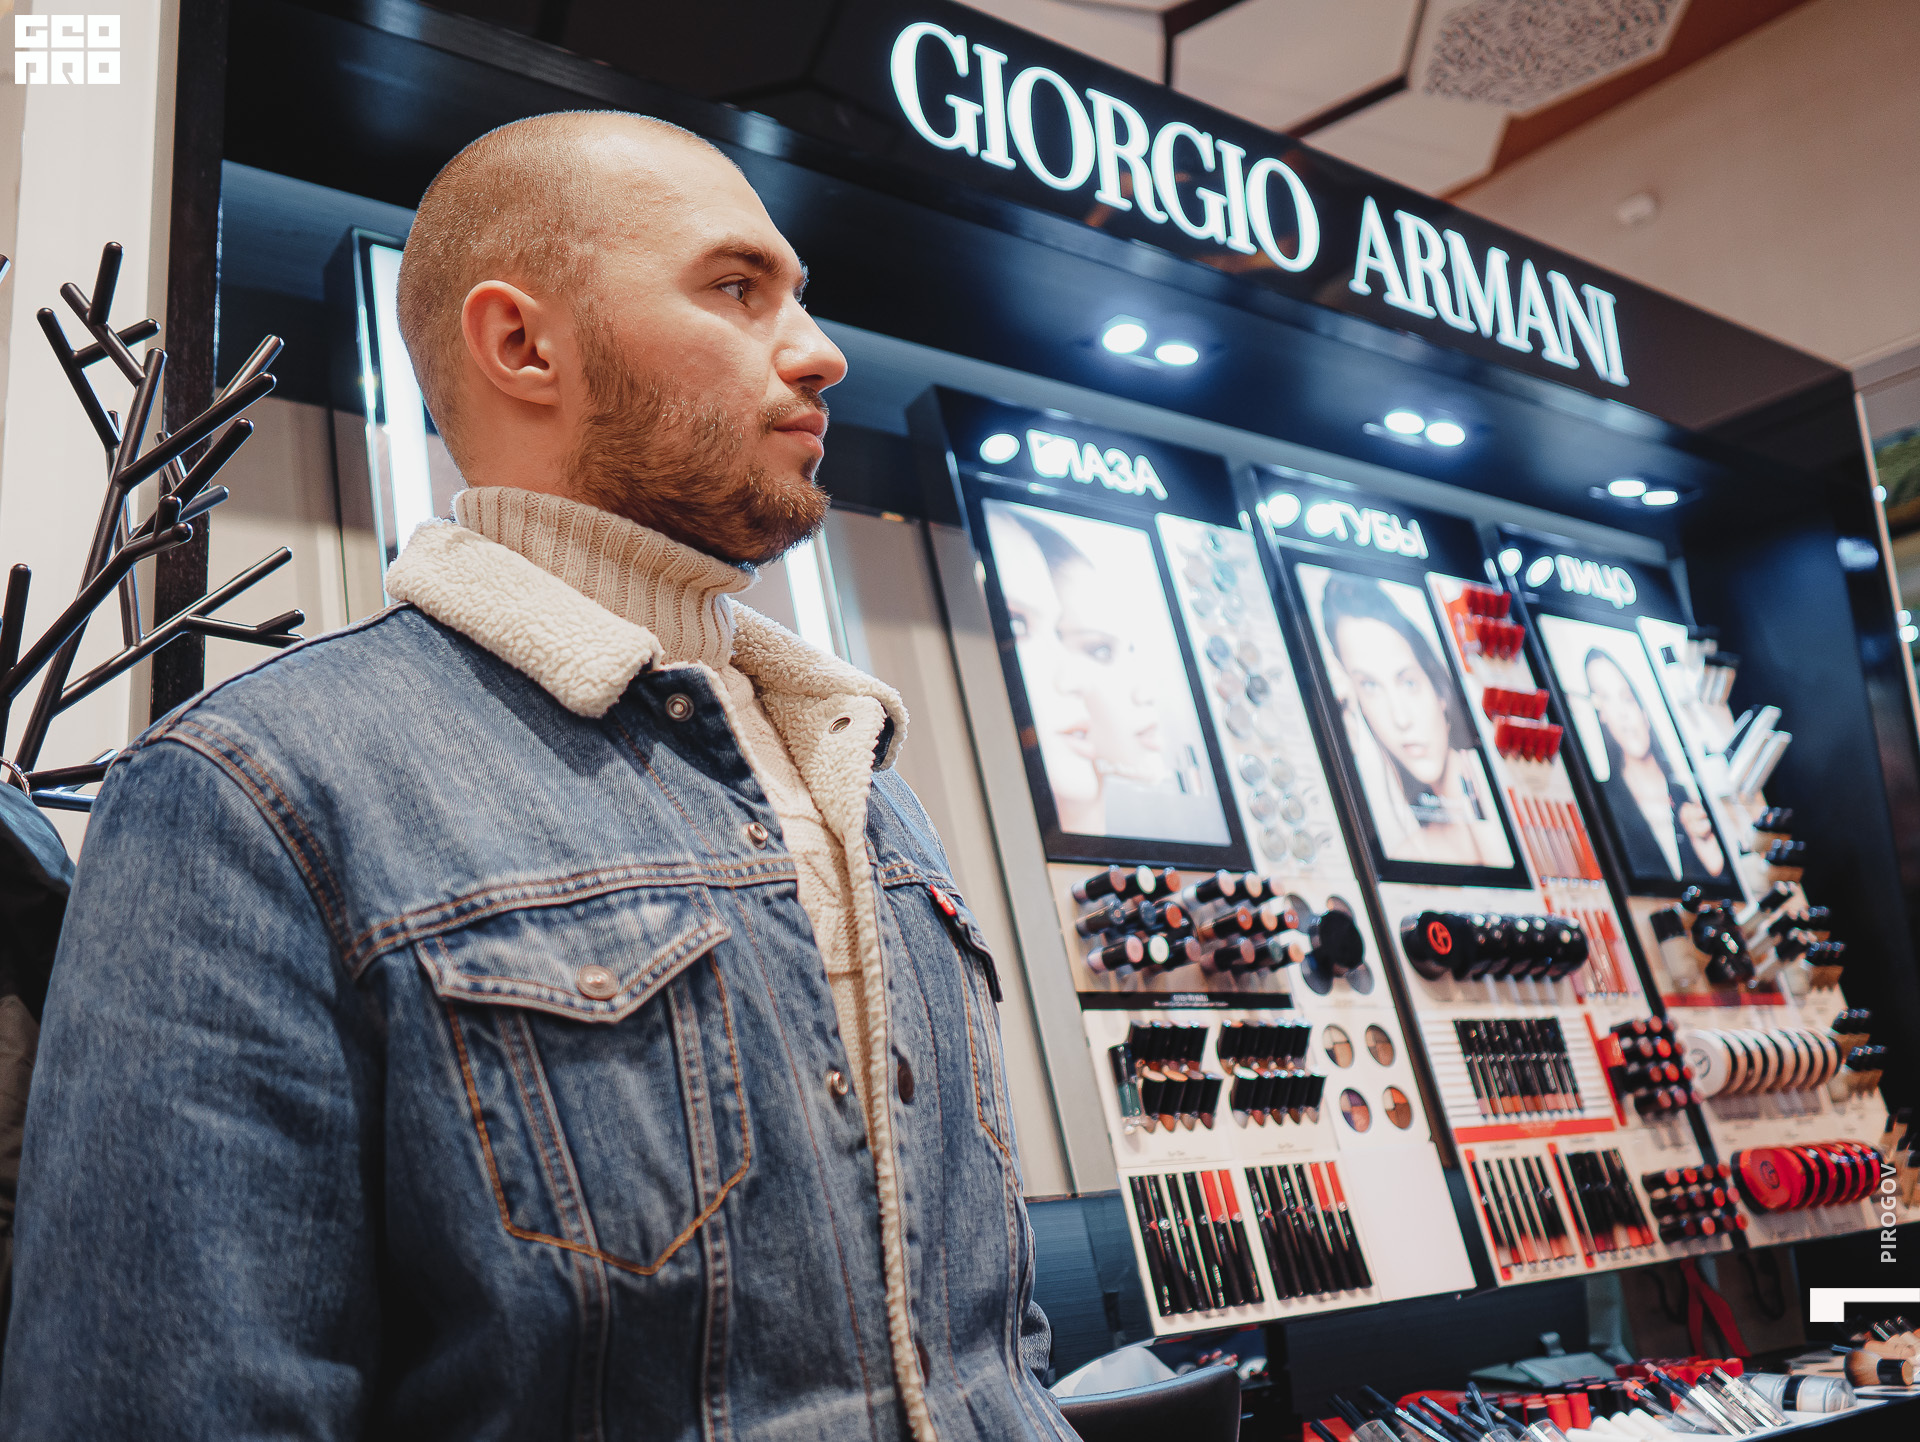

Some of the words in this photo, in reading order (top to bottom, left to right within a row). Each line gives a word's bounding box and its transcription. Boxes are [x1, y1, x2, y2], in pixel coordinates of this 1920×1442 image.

[890, 21, 1320, 273] GIORGIO
[1348, 195, 1630, 387] ARMANI
[1328, 499, 1430, 560] ГУБЫ
[1554, 554, 1637, 610] ЛИЦО
